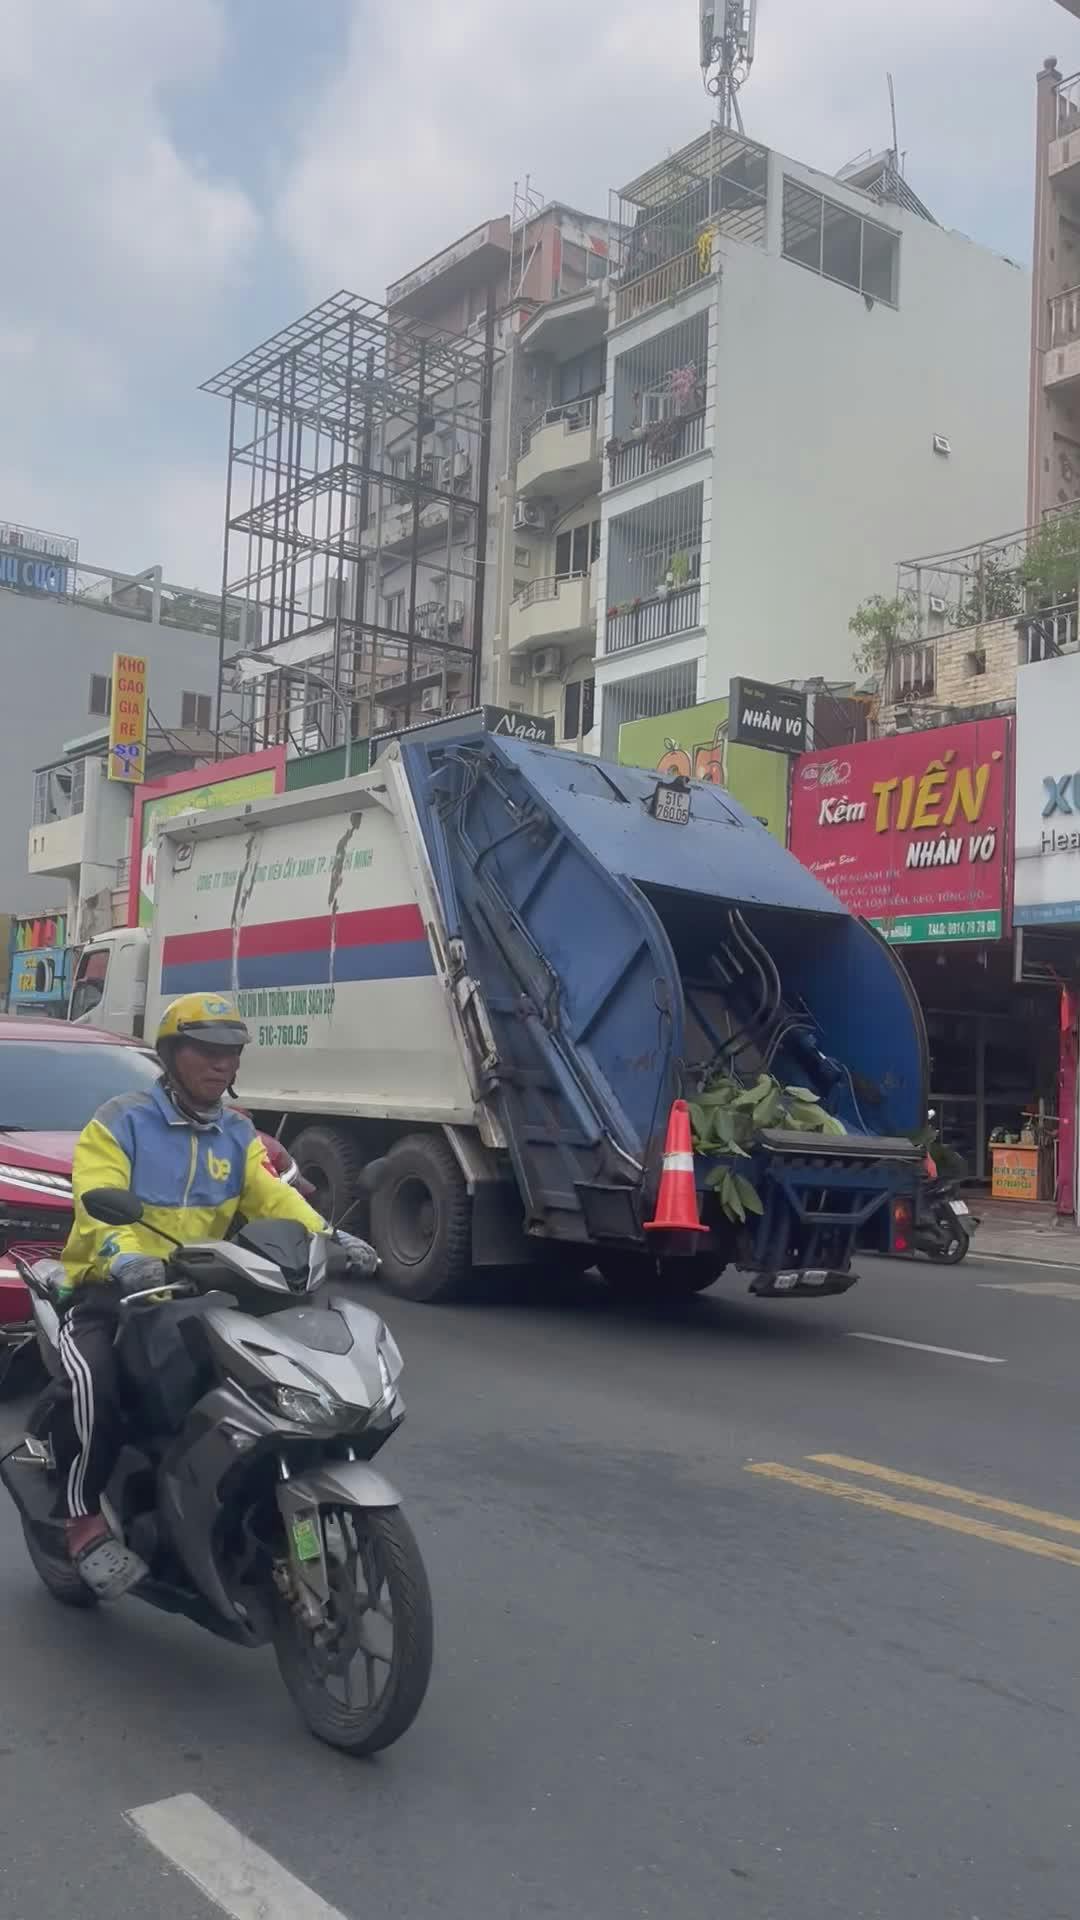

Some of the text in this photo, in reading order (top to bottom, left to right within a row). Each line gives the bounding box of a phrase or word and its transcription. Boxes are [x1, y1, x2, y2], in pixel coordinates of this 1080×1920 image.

[117, 656, 145, 674] KHO
[488, 713, 546, 740] Ngàn
[742, 708, 783, 733] NHÂN
[665, 791, 685, 808] 51C
[871, 750, 991, 834] TIẾN
[818, 795, 868, 826] Kềm
[905, 826, 999, 869] NHÂN VÕ
[259, 1024, 309, 1046] 51C-760.05
[207, 1147, 231, 1181] be
